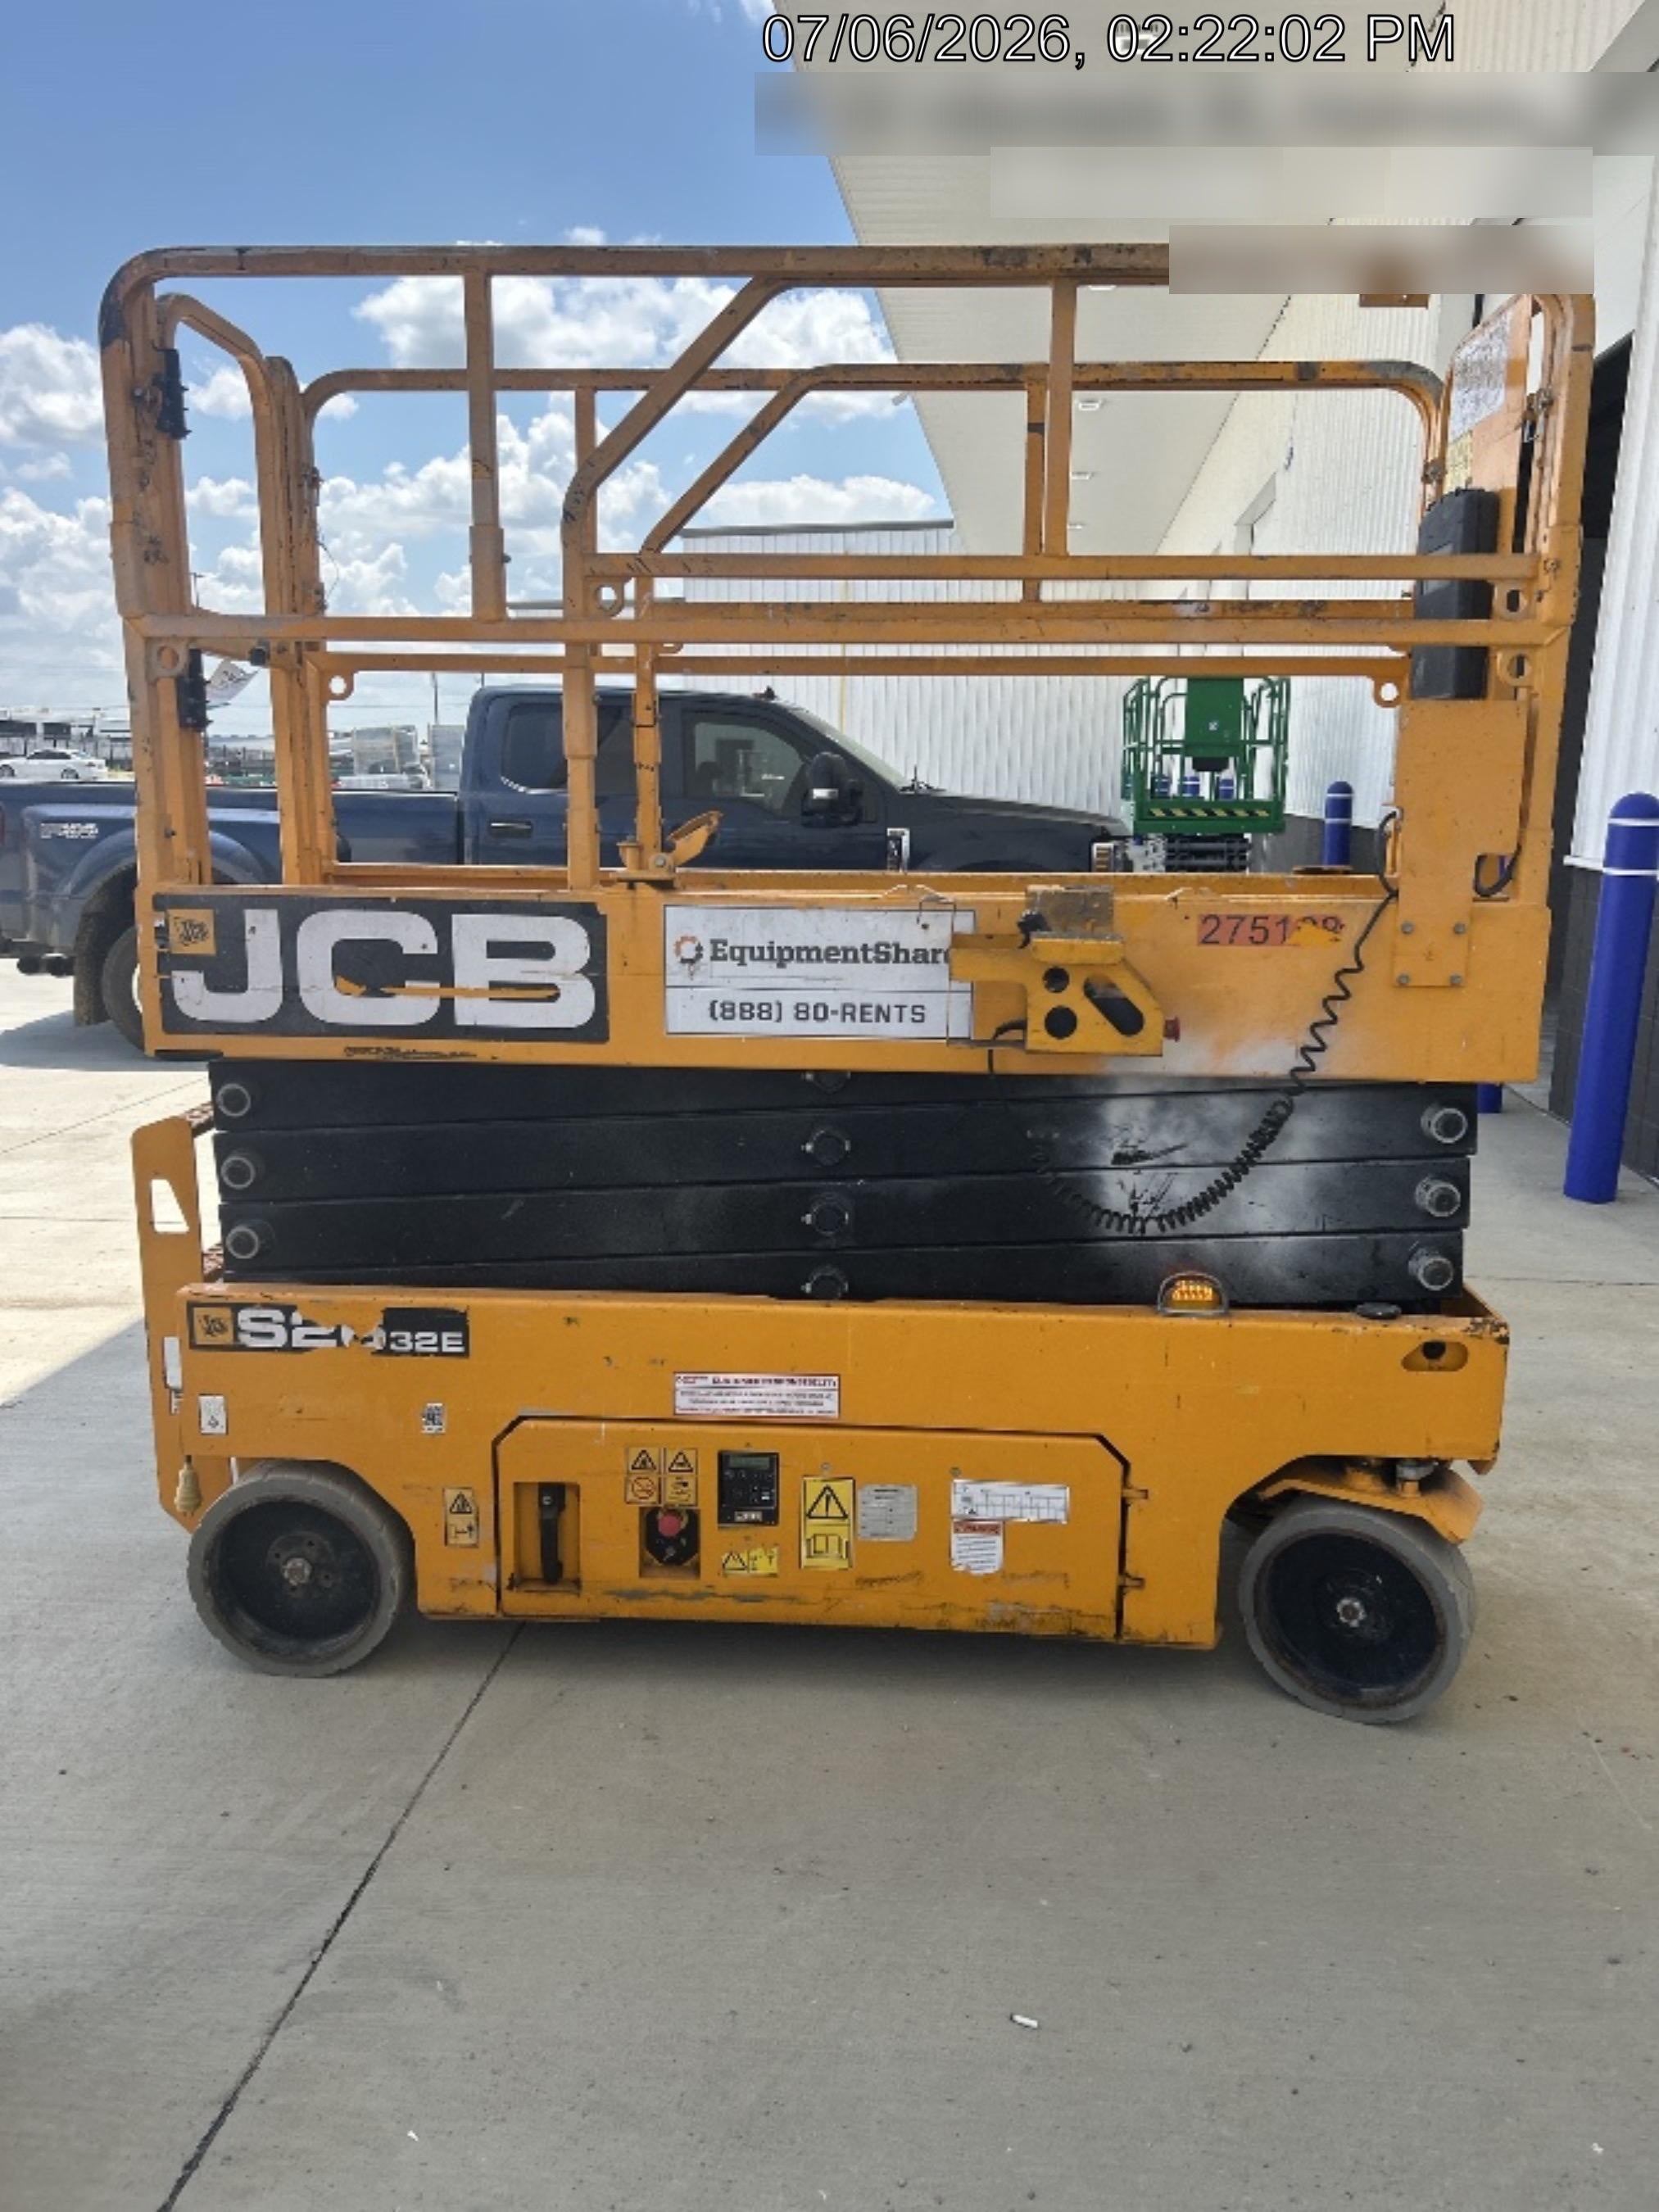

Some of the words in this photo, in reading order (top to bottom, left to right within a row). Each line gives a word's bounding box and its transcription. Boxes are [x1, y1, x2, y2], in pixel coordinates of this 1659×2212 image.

[171, 909, 596, 1028] JCB
[709, 1000, 782, 1023] (888)
[793, 1001, 926, 1023] 80-RENTS
